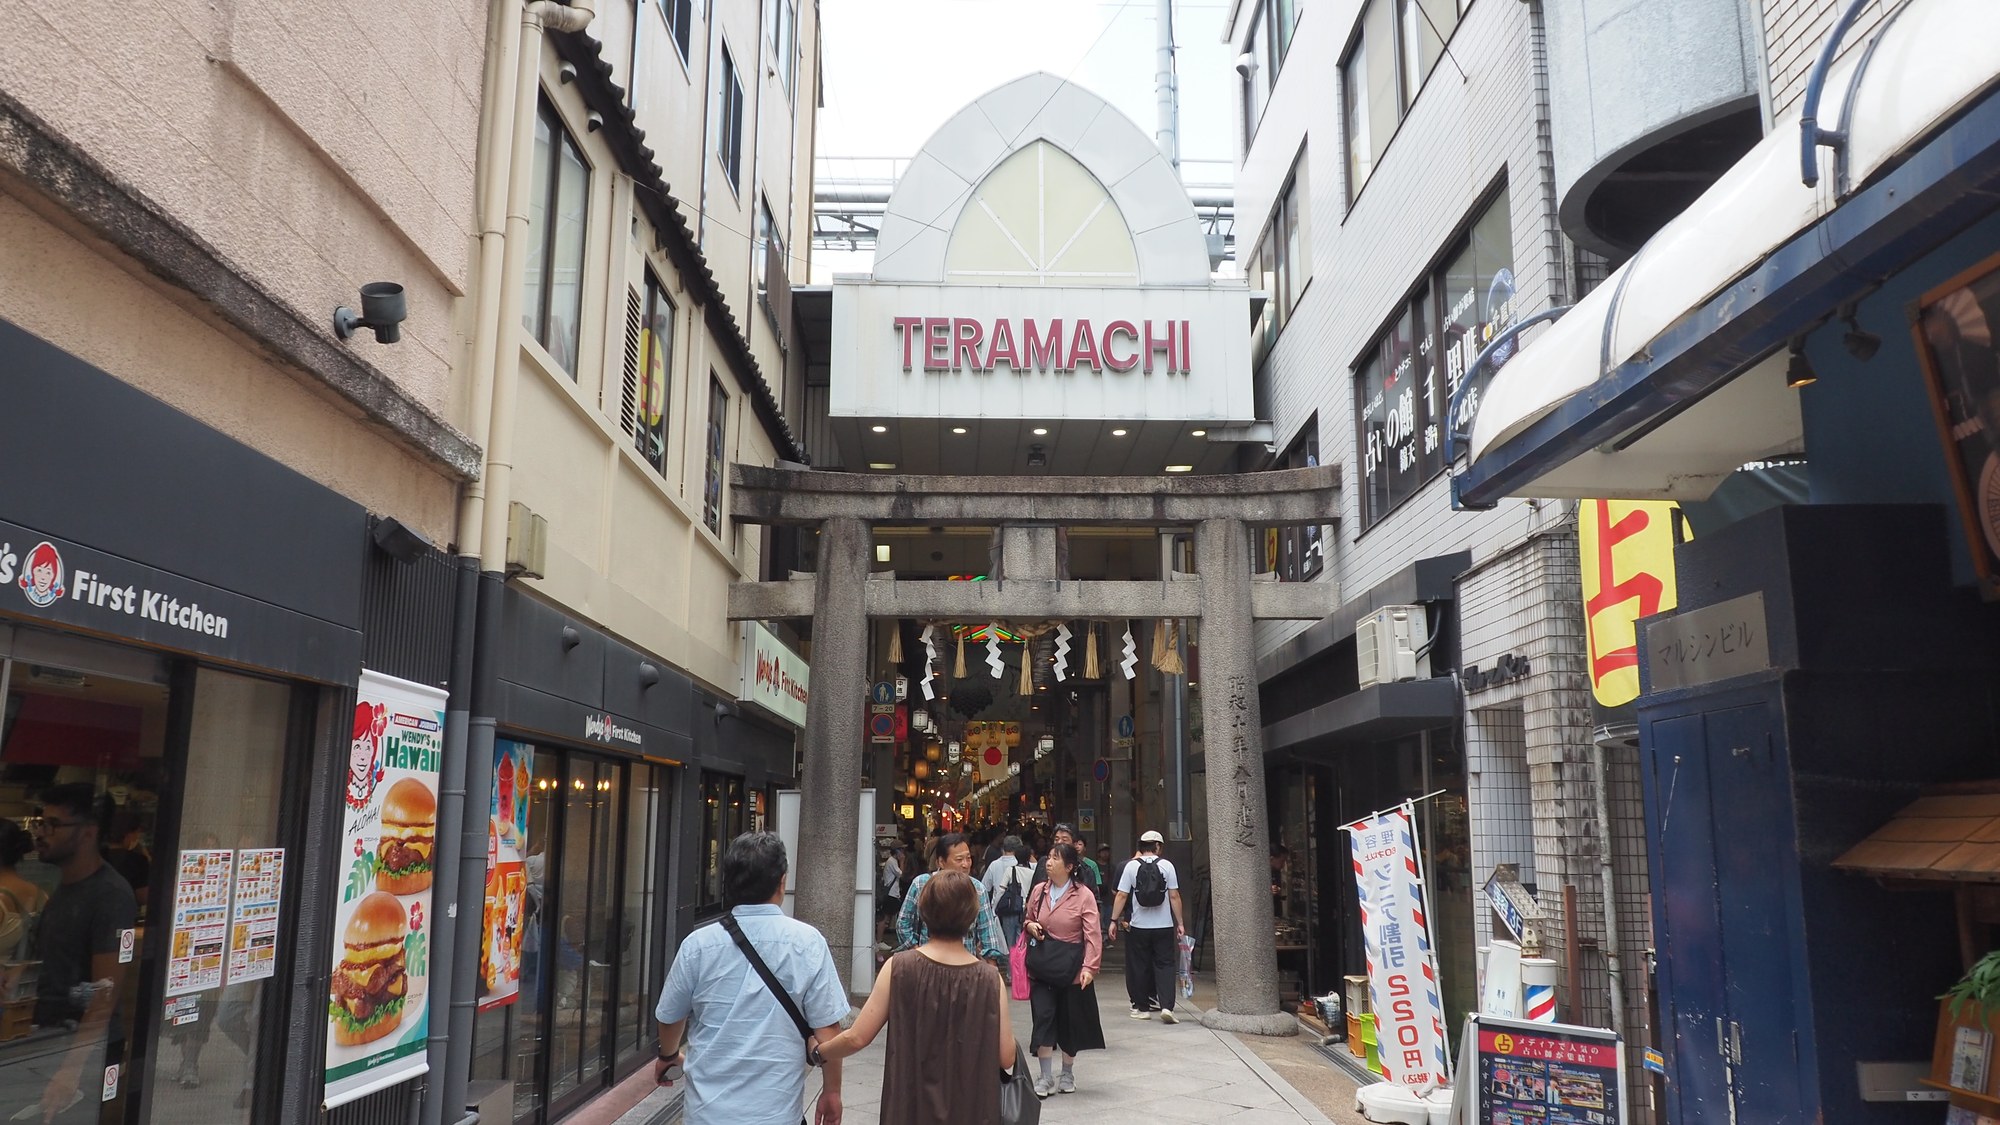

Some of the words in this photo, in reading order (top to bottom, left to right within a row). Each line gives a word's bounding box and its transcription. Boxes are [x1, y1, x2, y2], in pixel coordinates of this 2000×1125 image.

[894, 316, 1192, 374] TERAMACHI
[1365, 386, 1415, 478] 占いの館
[71, 569, 136, 615] First
[140, 589, 228, 639] Kitchen
[1657, 620, 1754, 666] マルシンビル
[401, 730, 431, 746] WENDY'S
[585, 714, 604, 741] Wendy's
[612, 724, 624, 740] First
[623, 727, 642, 745] Kitchen
[385, 735, 441, 773] Hawaii
[348, 804, 381, 836] ALOHA!
[1510, 907, 1522, 933] 3F
[1498, 1034, 1511, 1051] 占
[1518, 1037, 1599, 1055] メディアで人気の
